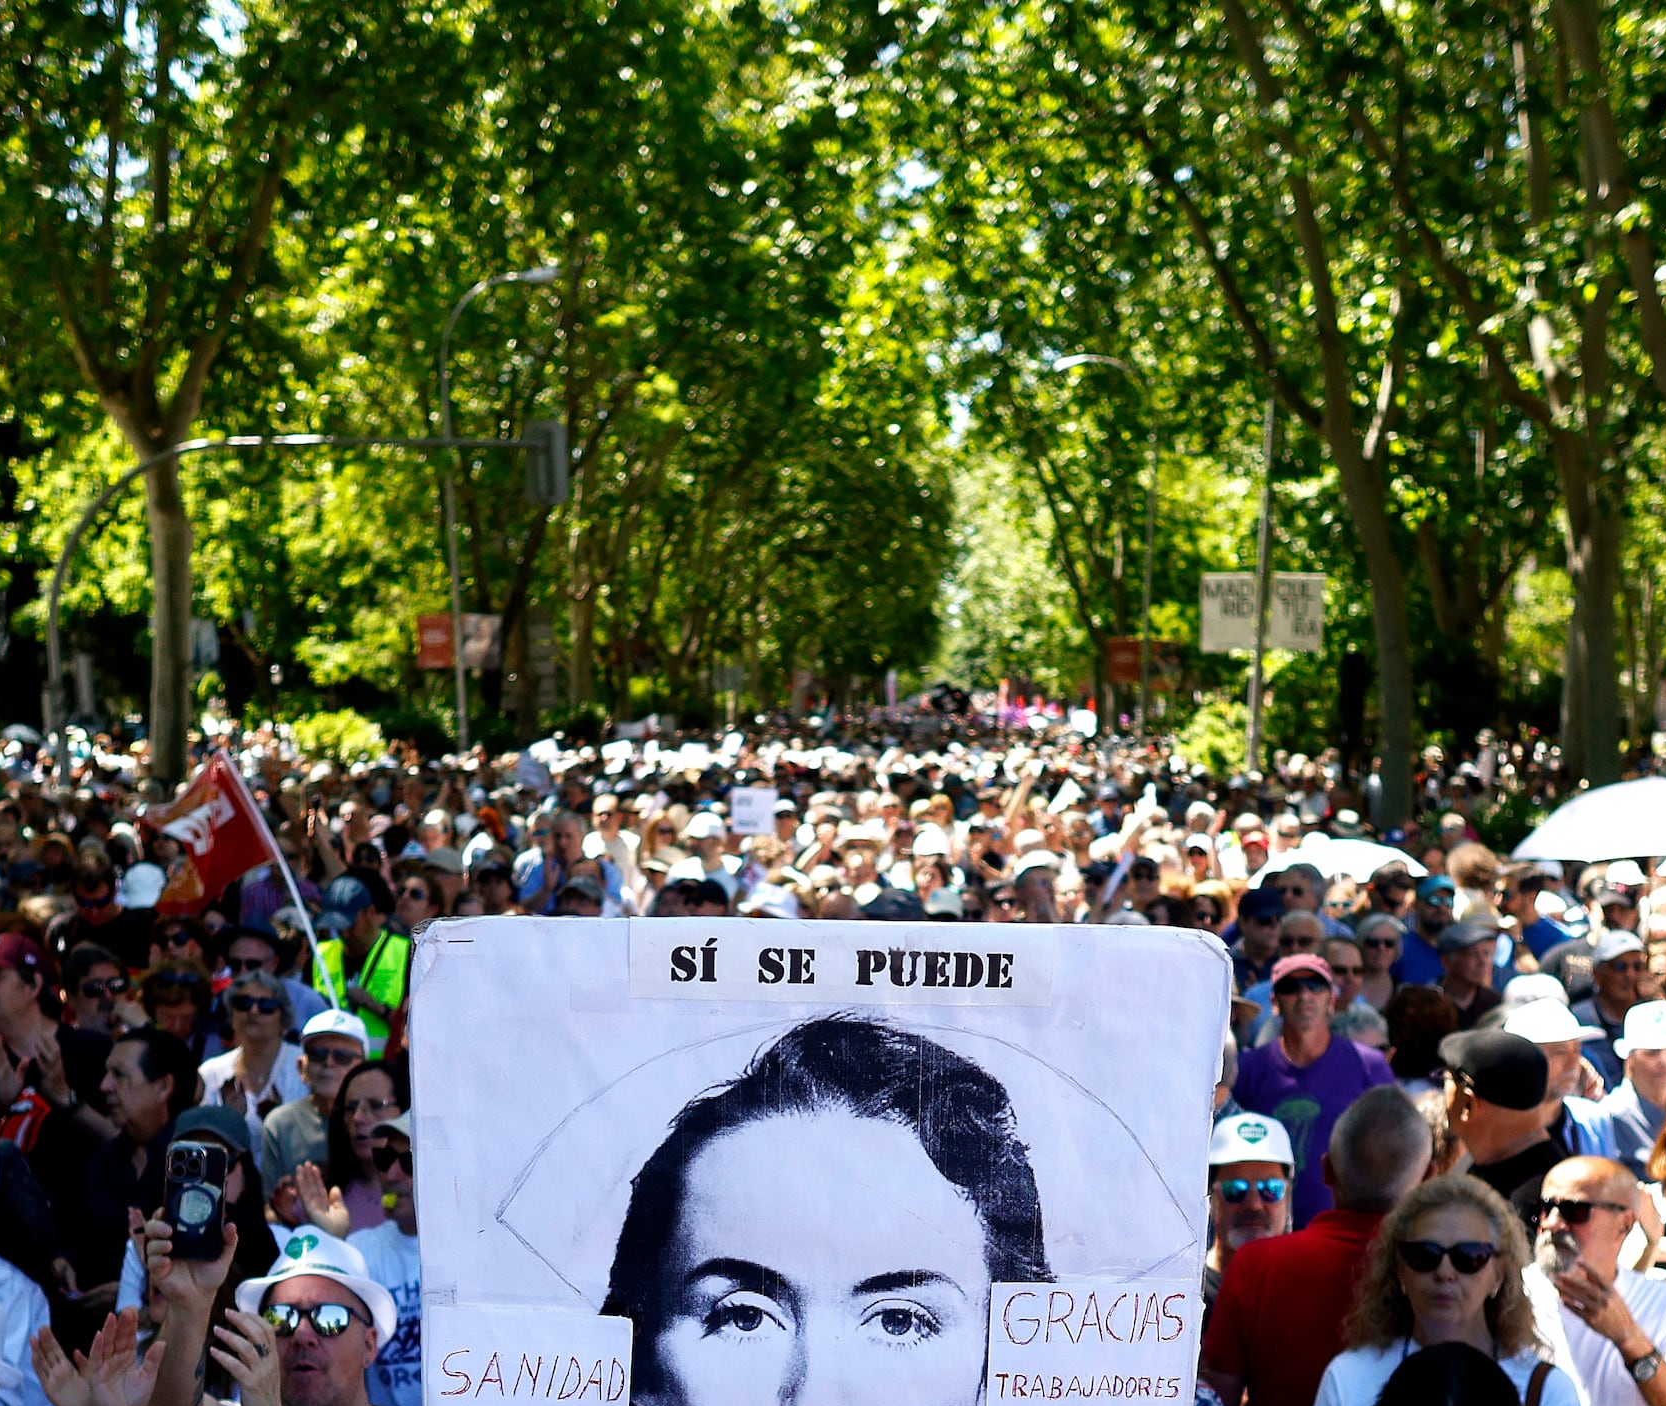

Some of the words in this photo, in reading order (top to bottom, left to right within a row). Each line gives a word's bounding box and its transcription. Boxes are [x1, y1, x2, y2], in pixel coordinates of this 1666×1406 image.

[670, 937, 718, 983] SÍ
[758, 948, 815, 984] SE
[855, 947, 1014, 989] PUEDE
[1002, 1290, 1186, 1346] GRACIAS
[440, 1349, 626, 1402] SANIDAD
[995, 1373, 1181, 1400] TRABAJADORES
